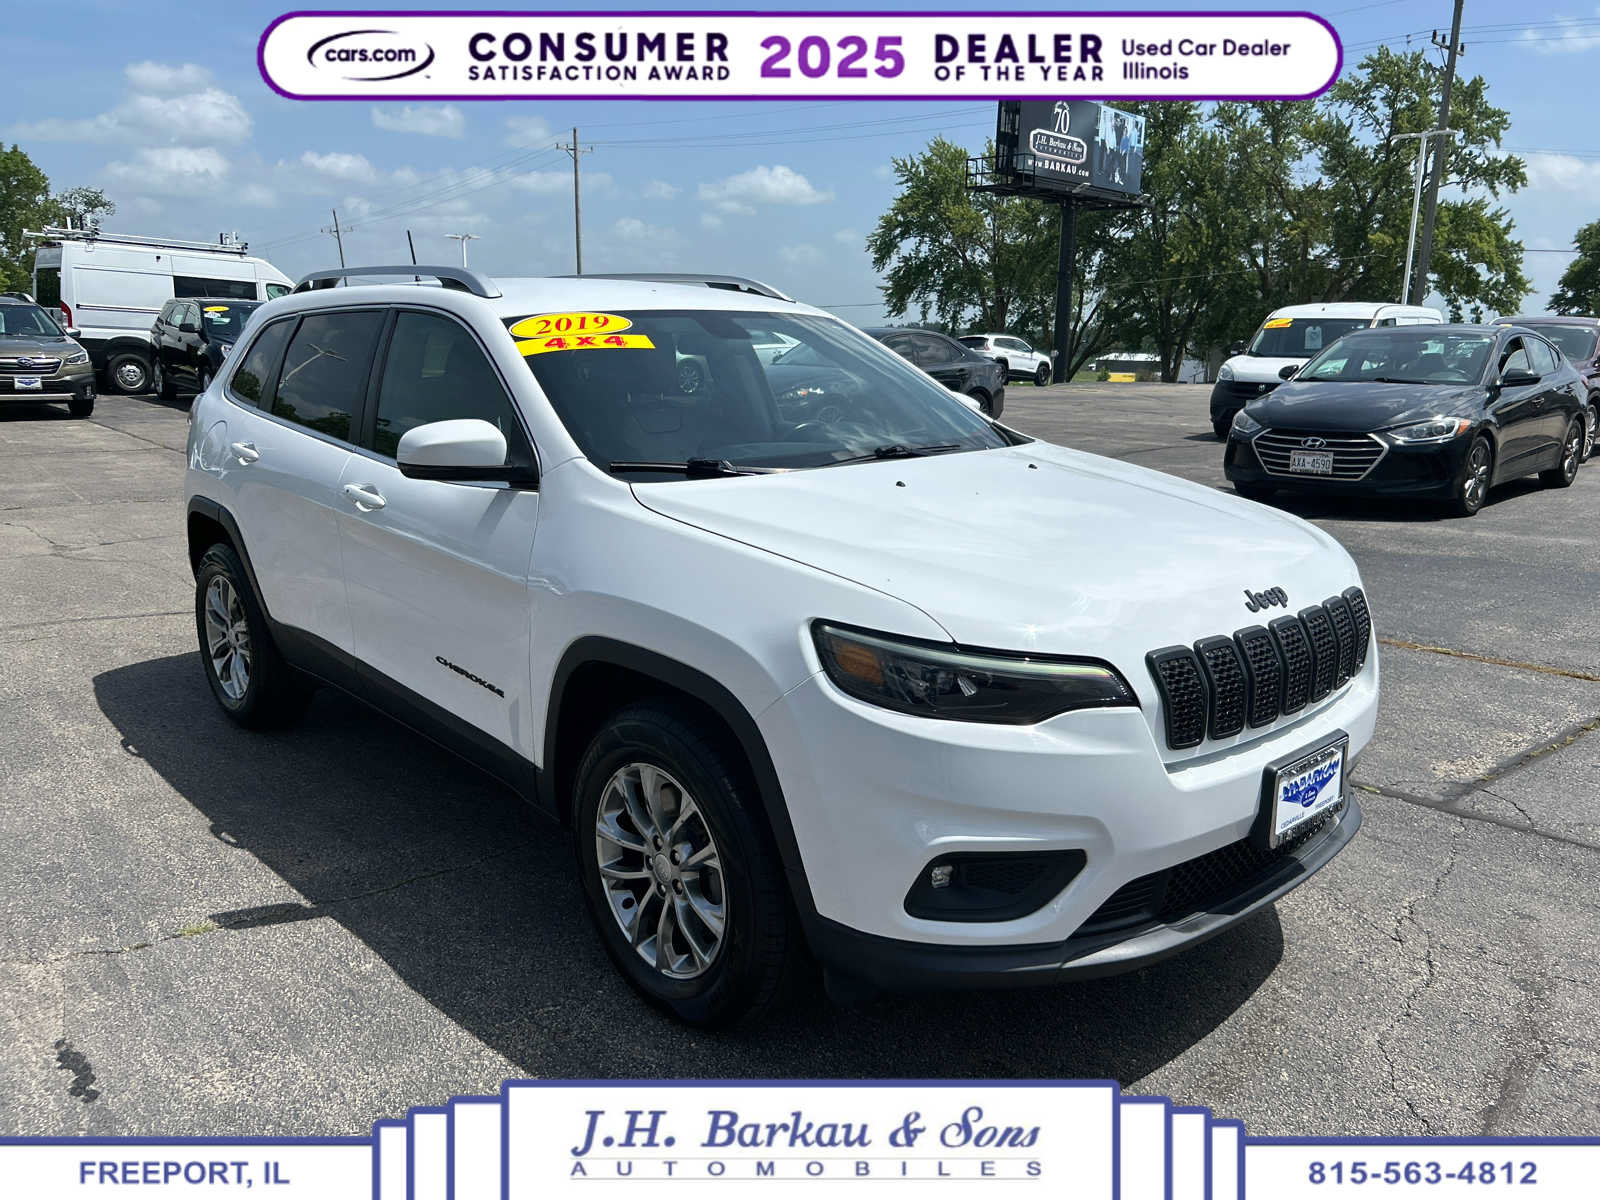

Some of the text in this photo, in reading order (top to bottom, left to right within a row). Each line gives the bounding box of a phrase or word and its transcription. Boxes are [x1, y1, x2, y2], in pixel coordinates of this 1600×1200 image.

[1053, 107, 1070, 134] 70
[536, 315, 609, 335] 2019
[1243, 586, 1289, 613] Jeep
[435, 655, 505, 699] CHEROKEE
